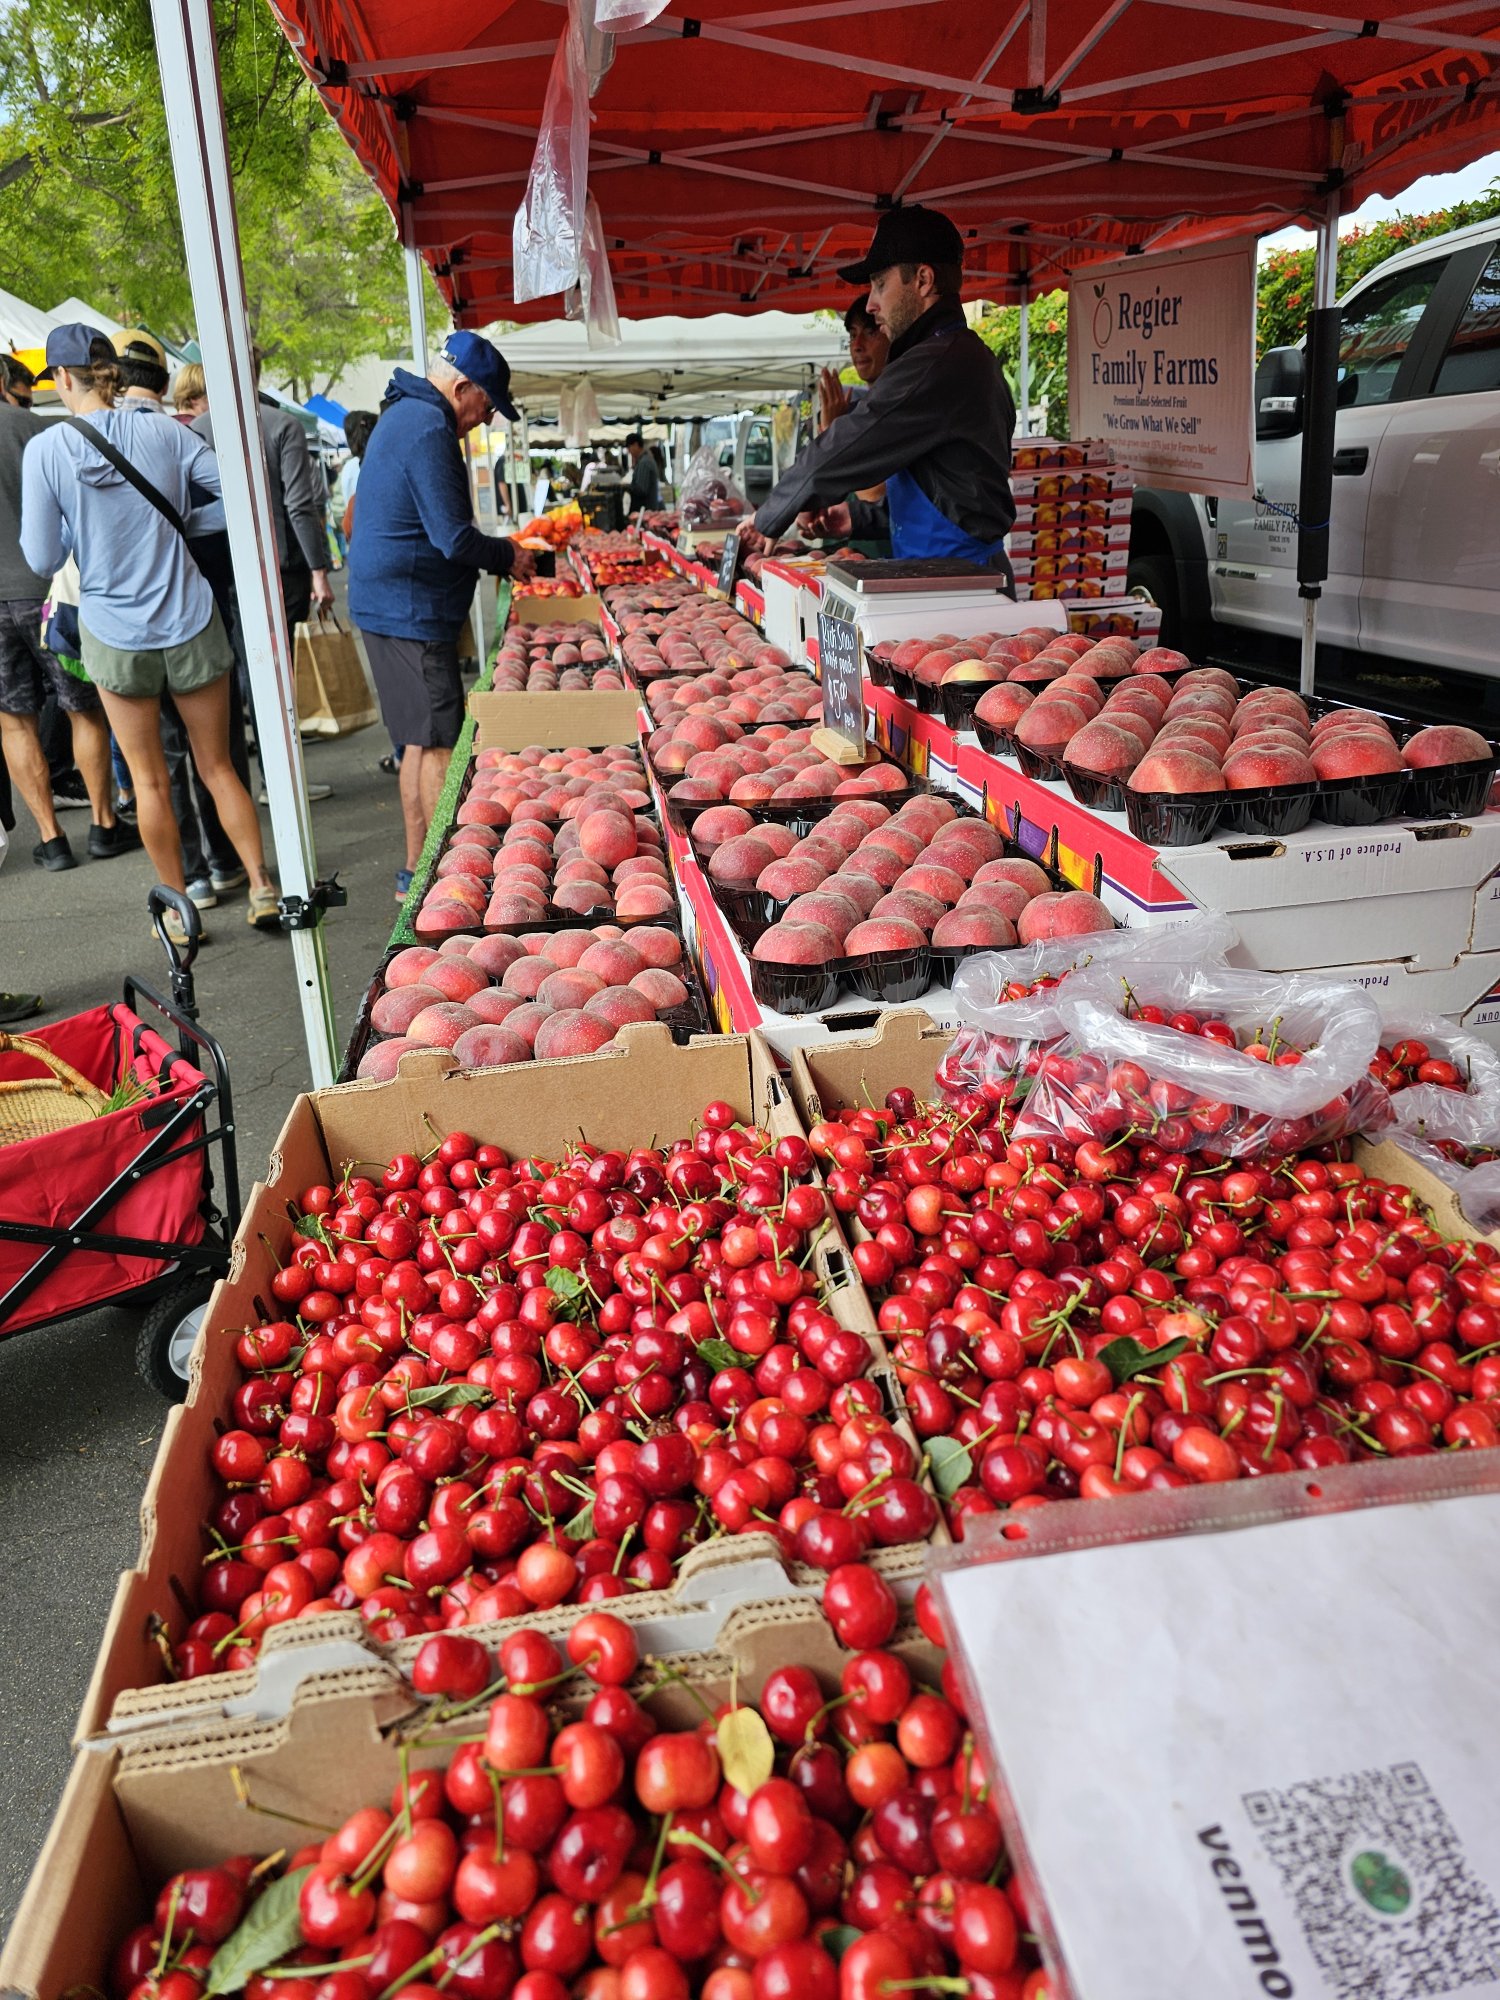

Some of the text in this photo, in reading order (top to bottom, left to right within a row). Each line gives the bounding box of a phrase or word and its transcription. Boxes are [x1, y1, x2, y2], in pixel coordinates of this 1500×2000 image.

[1118, 285, 1182, 339] Regier
[1091, 349, 1218, 394] Family Farms
[1113, 395, 1188, 408] Premium Hand-Selected Fruit
[1103, 413, 1202, 435] "We Grow What We Sell"
[1266, 503, 1298, 517] REGIER
[1254, 519, 1281, 532] FAMILY
[820, 614, 838, 650] Rich
[1300, 842, 1402, 863] Produce of U.S.A.
[1477, 1010, 1500, 1023] OUNT
[1197, 1824, 1293, 1999] venmo
